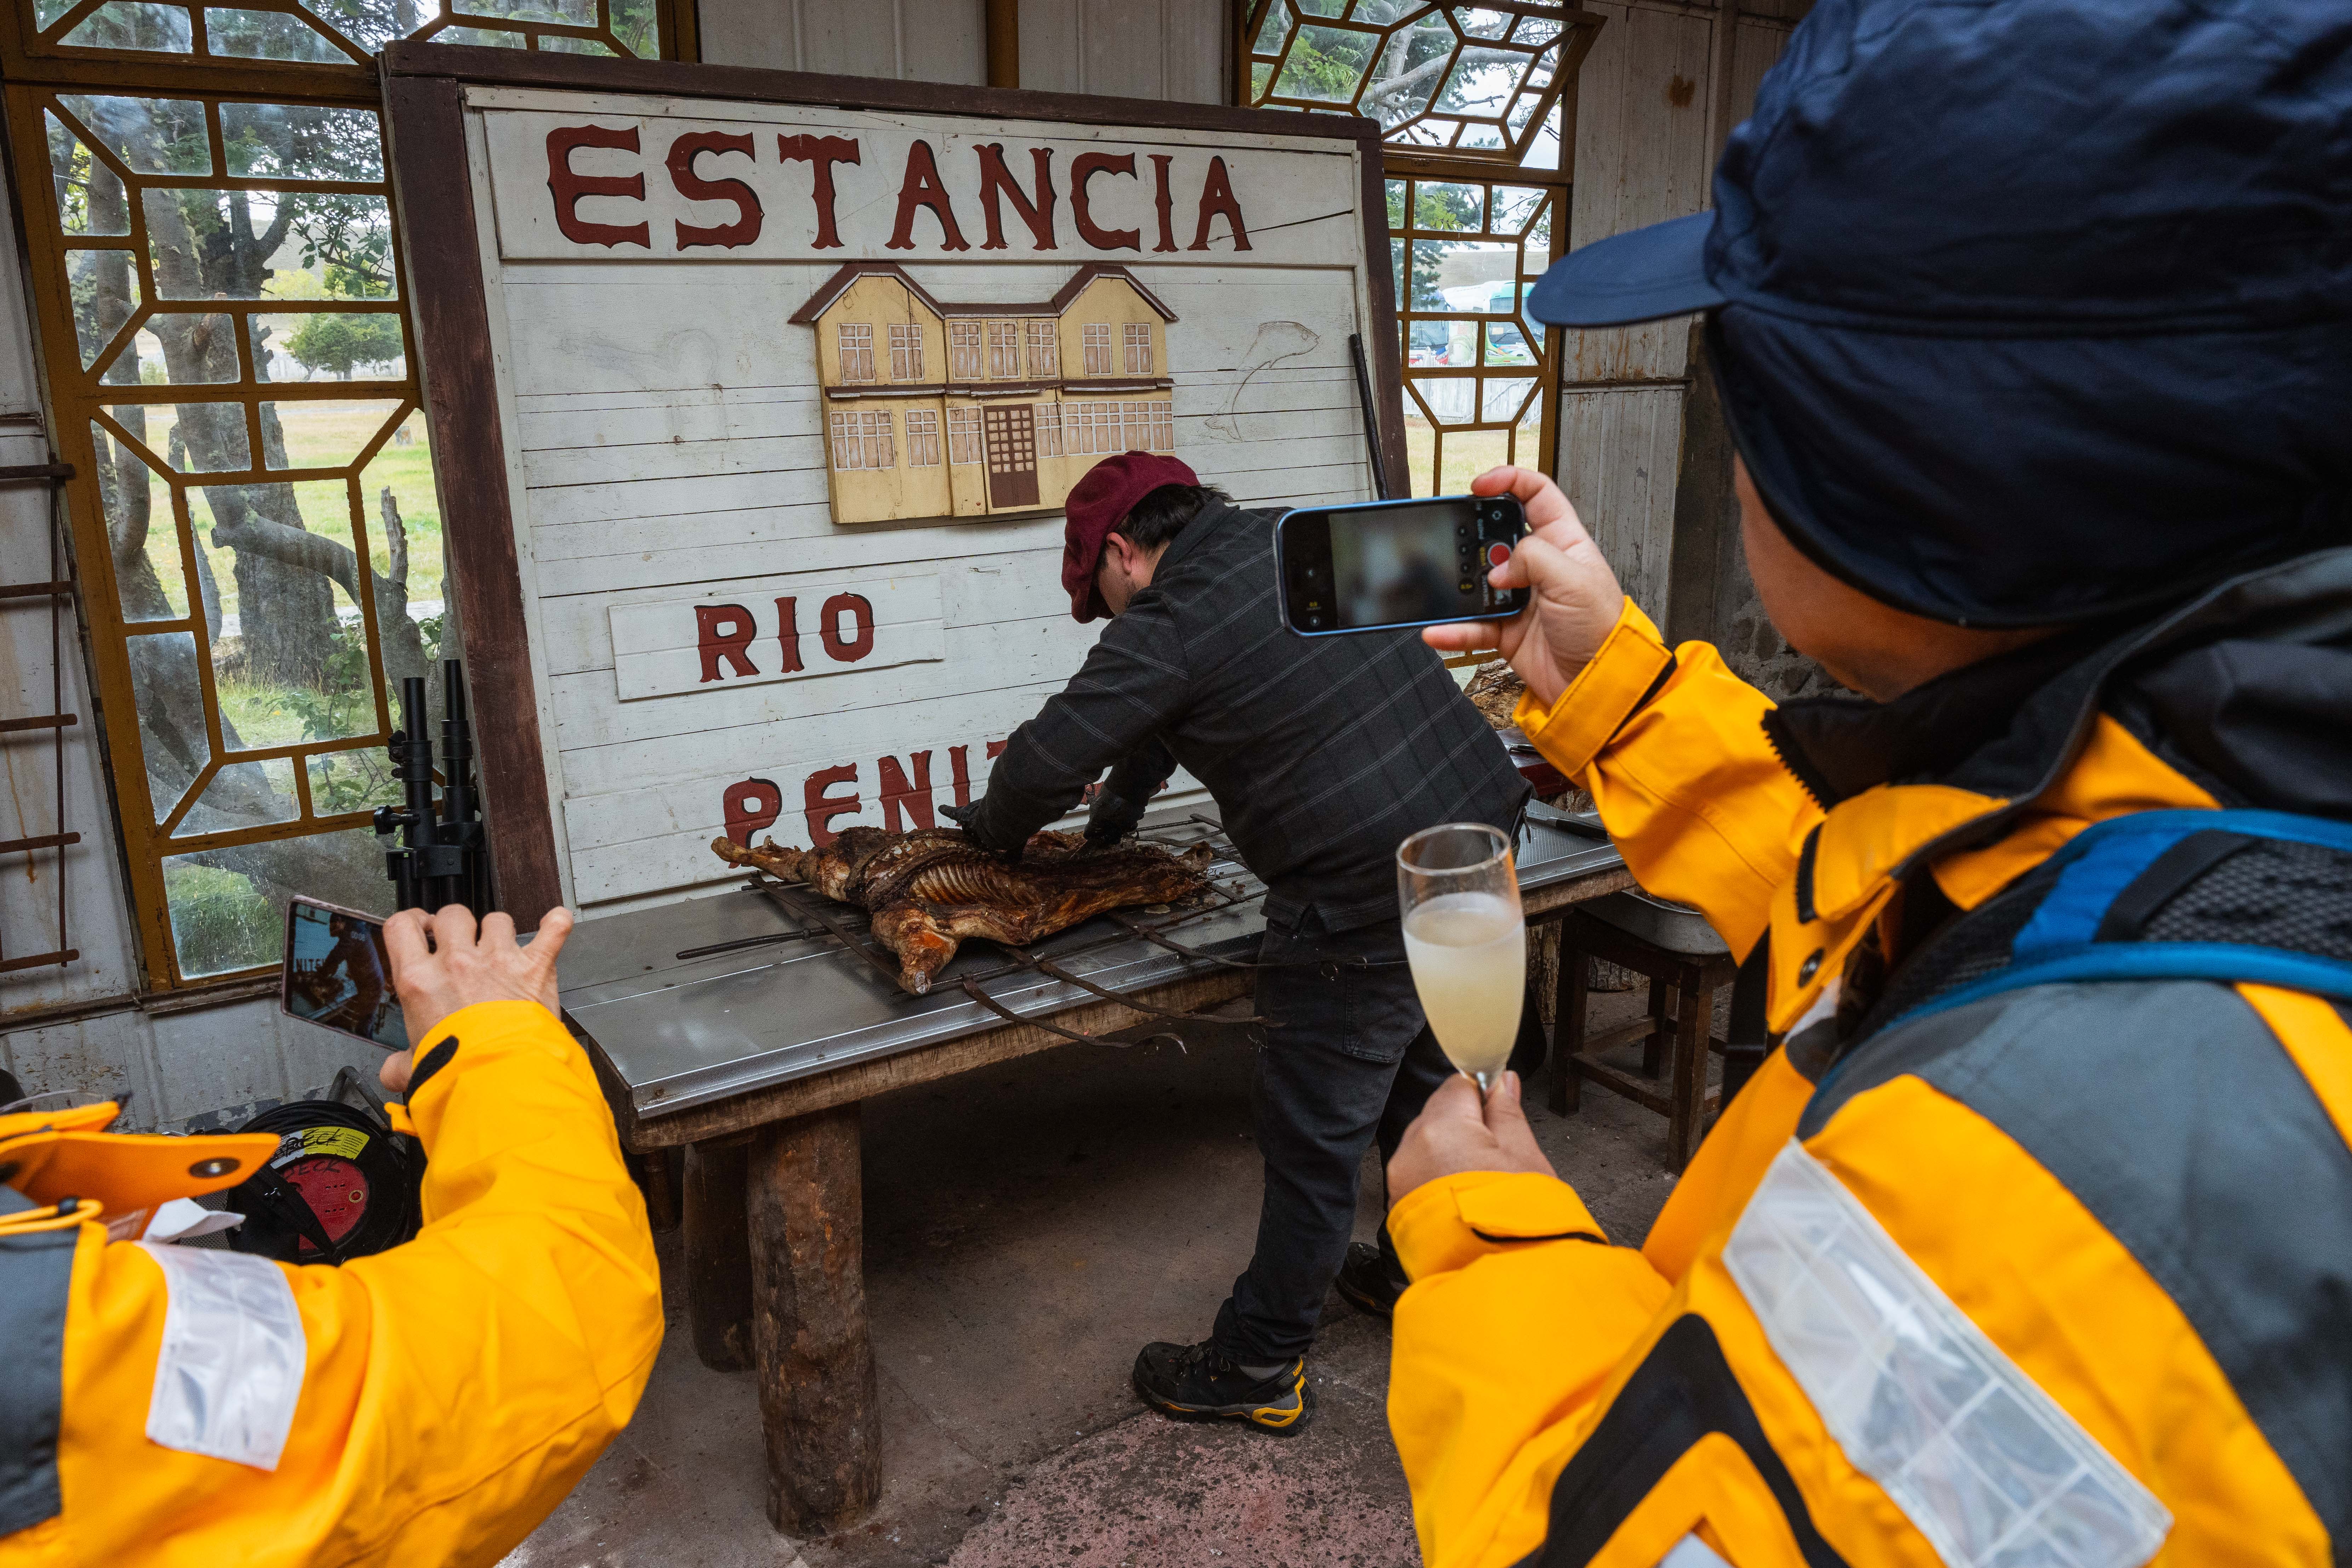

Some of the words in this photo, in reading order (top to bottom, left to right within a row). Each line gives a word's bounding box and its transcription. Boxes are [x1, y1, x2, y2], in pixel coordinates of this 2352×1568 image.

[546, 124, 1254, 253] ESTANCIA
[693, 591, 875, 683] RIO
[723, 740, 1008, 869] PENI
